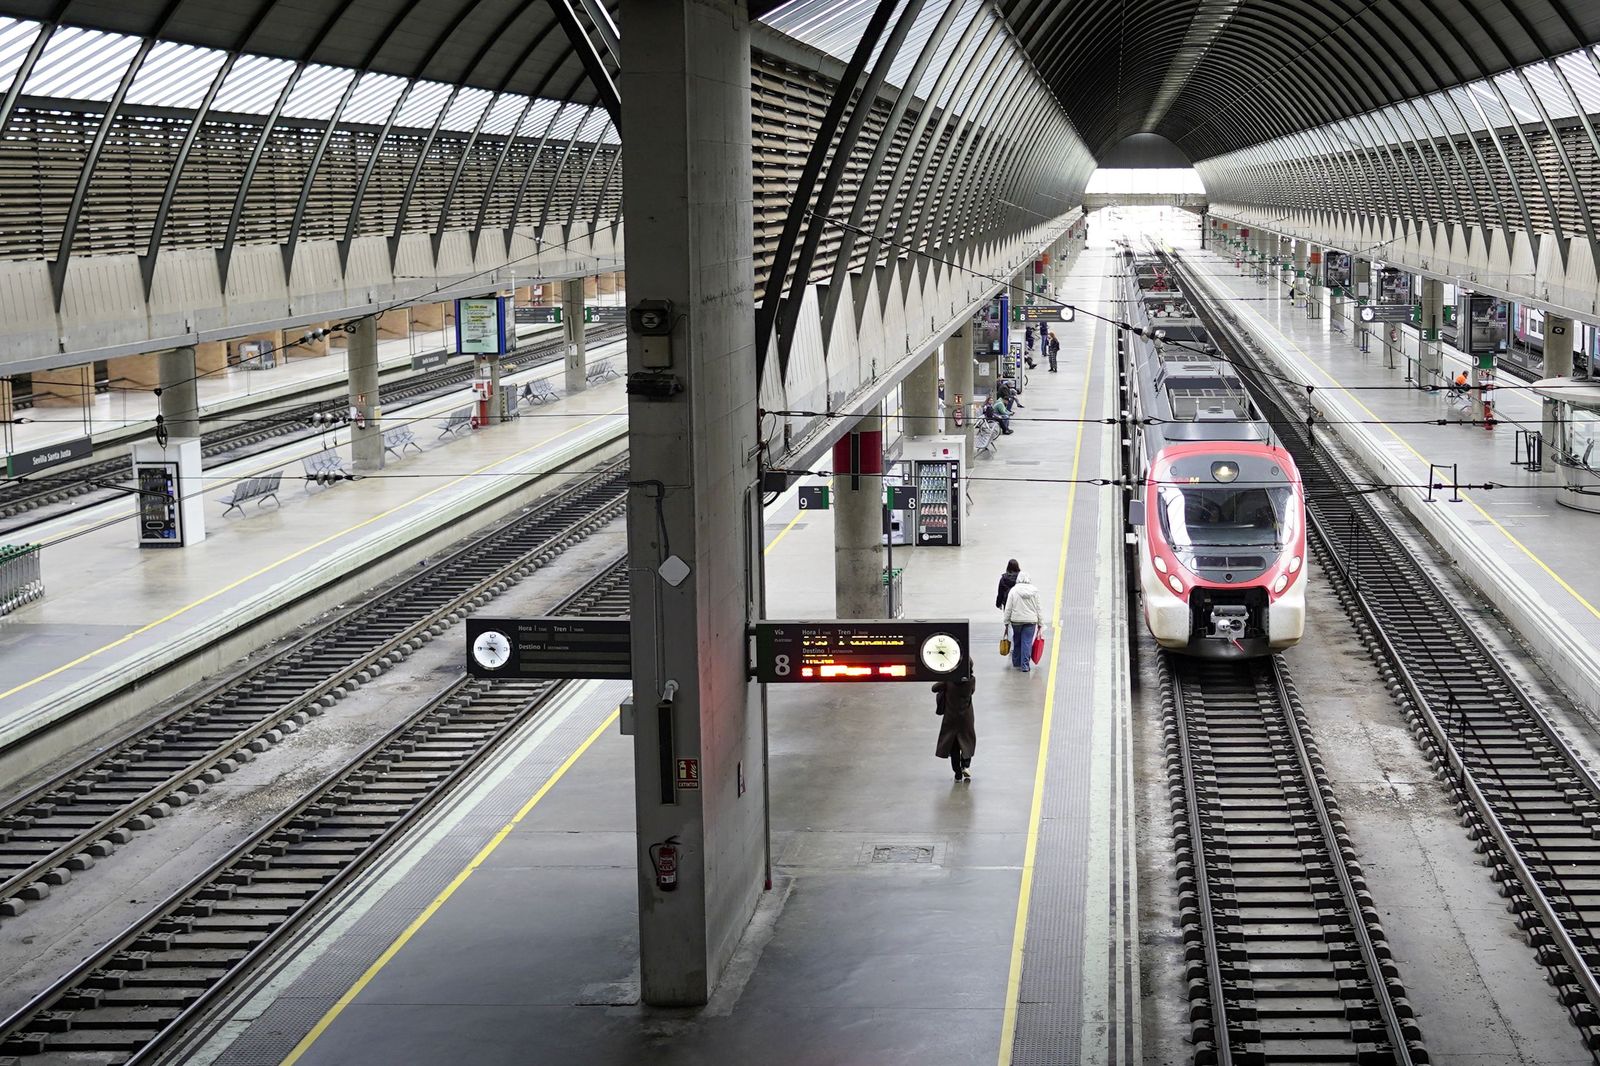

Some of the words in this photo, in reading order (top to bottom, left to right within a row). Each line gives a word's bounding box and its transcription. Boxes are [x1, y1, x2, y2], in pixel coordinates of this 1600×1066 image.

[1422, 330, 1427, 339] E
[1438, 330, 1442, 339] E
[1474, 356, 1480, 366] D
[1493, 356, 1498, 366] D
[47, 452, 60, 461] Santa
[800, 497, 808, 508] 9
[908, 497, 916, 509] 8
[775, 654, 790, 676] 8
